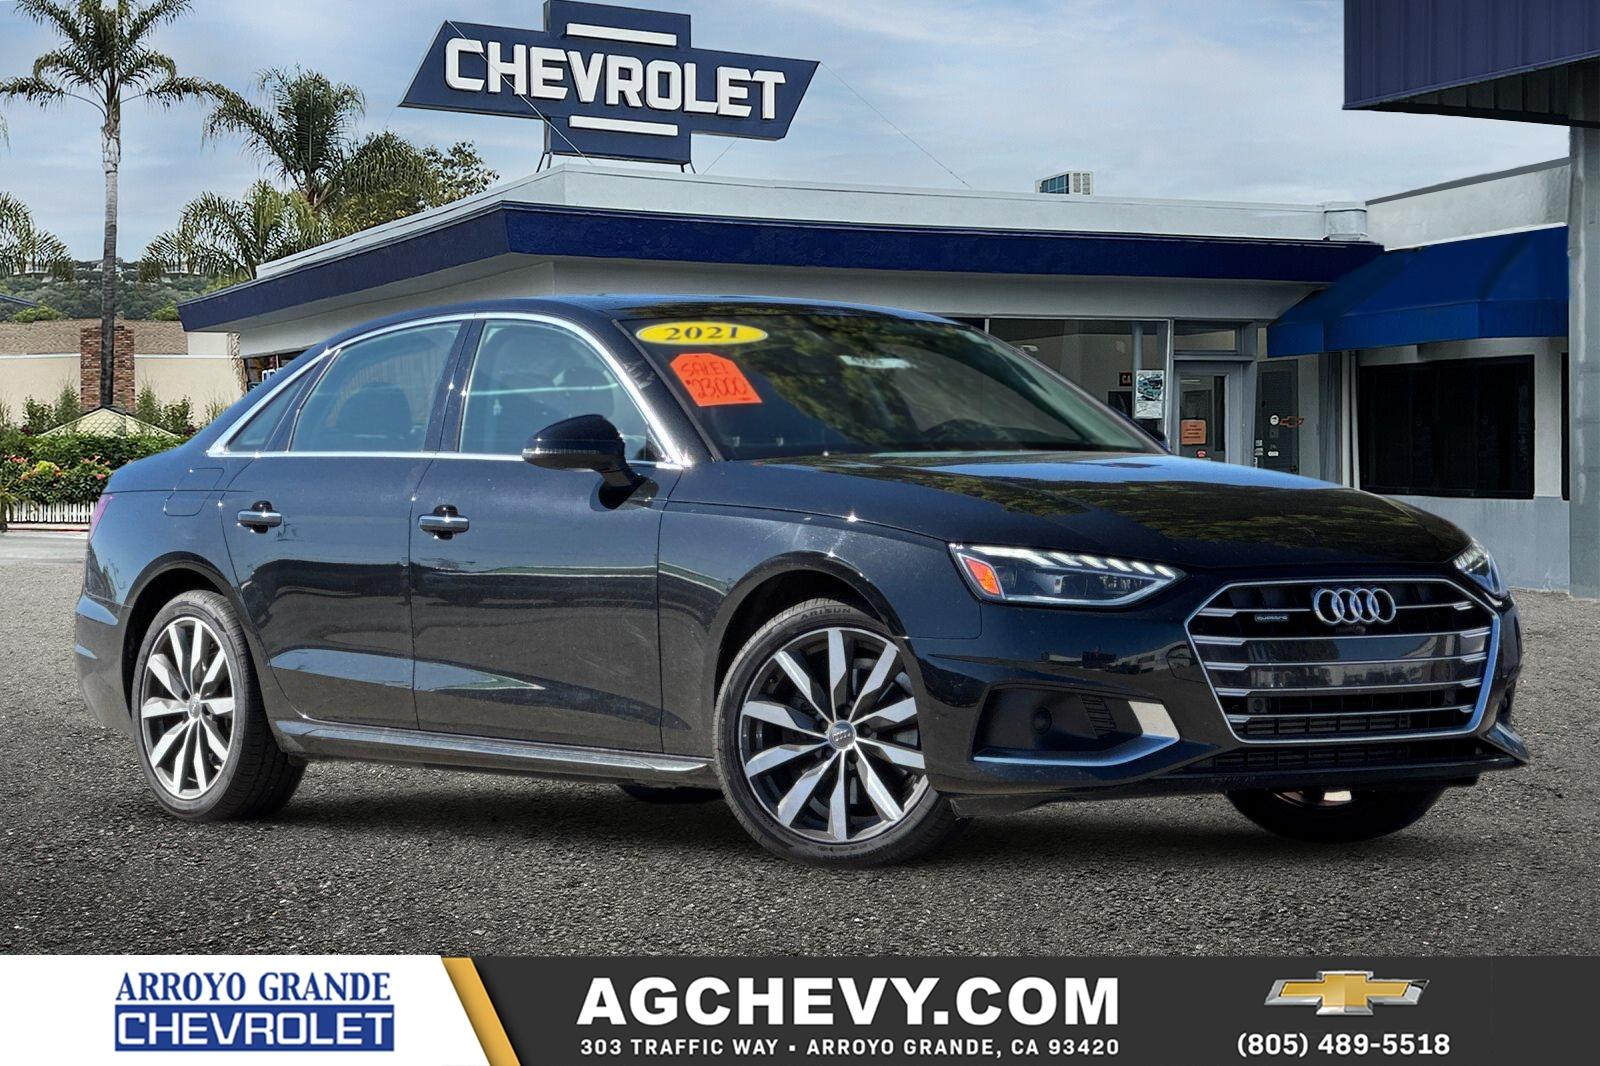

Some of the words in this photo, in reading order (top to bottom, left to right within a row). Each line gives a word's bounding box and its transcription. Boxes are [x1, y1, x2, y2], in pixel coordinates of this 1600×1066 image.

[445, 38, 786, 120] CHEVROLET
[665, 326, 739, 341] 2021
[681, 361, 728, 376] SALE!
[800, 607, 852, 620] ARISUN
